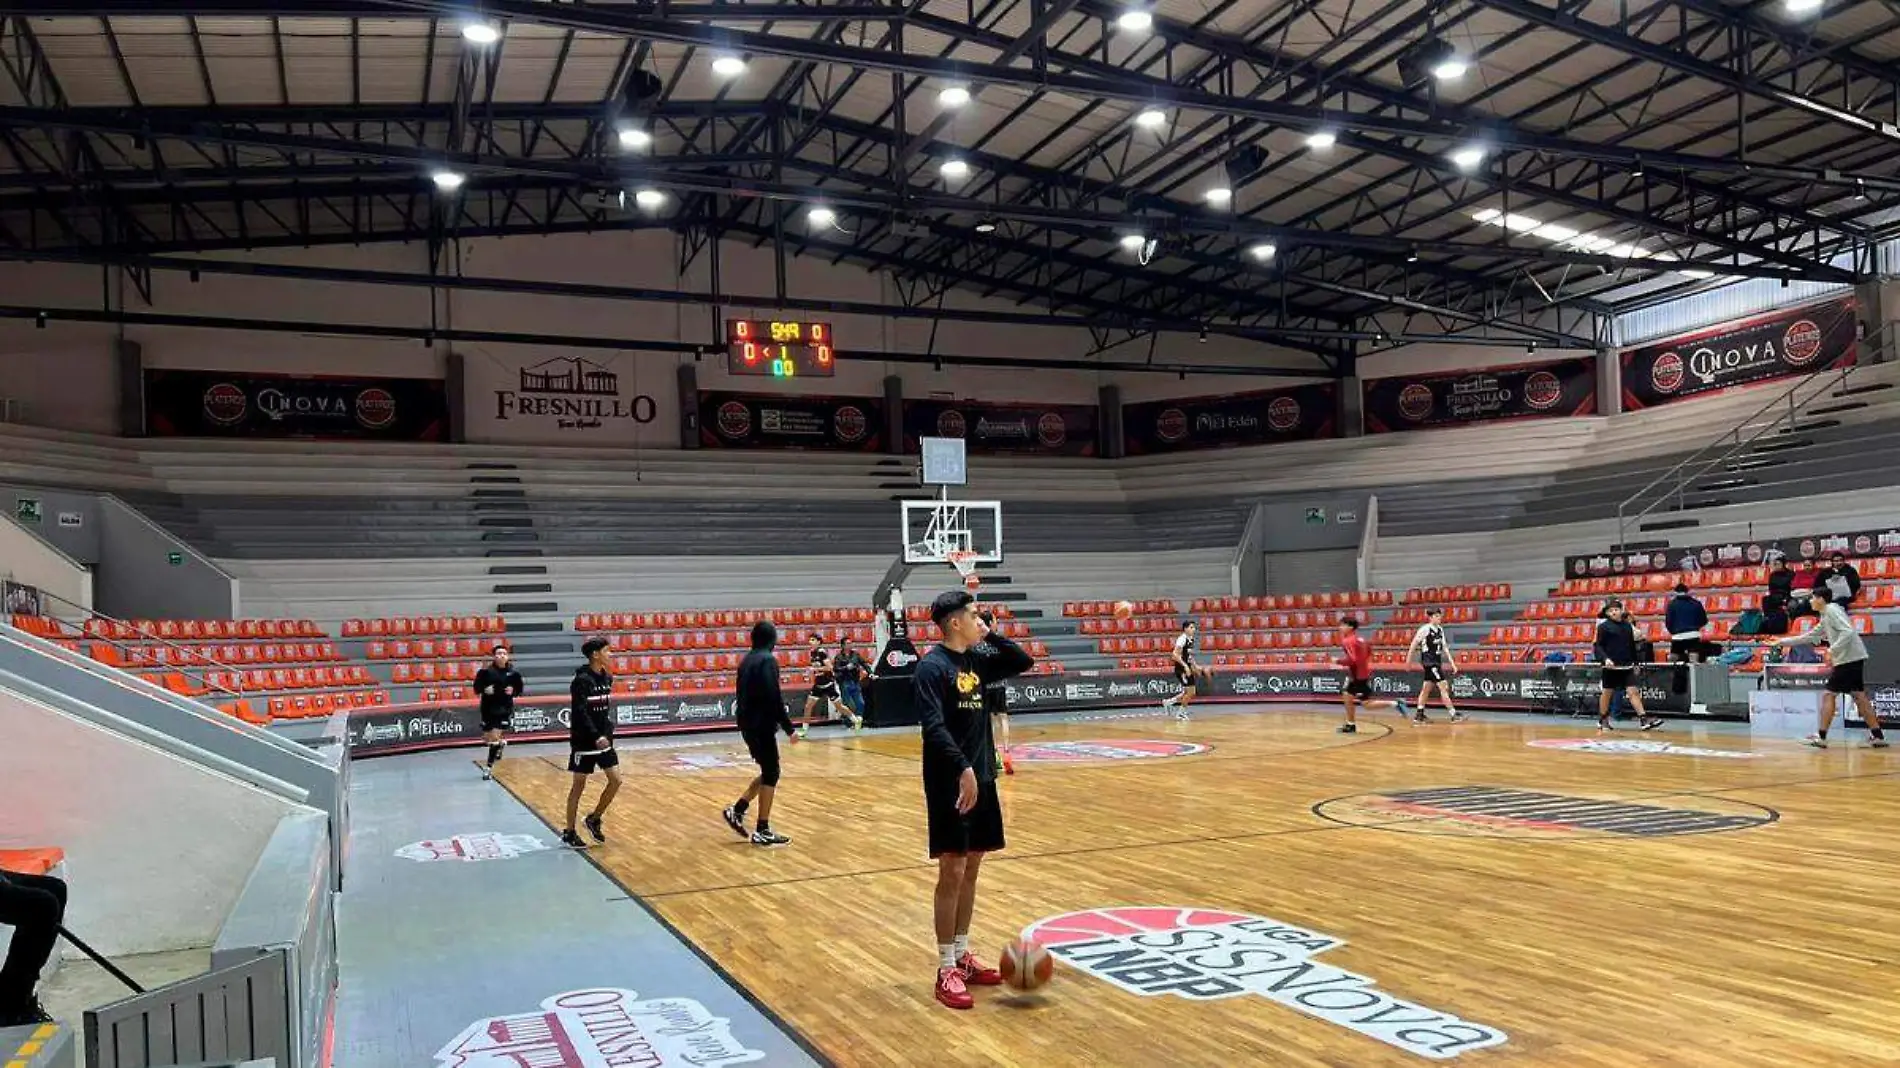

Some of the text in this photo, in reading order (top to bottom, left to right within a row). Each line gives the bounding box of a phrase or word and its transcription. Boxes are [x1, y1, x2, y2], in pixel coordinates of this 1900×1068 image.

[737, 321, 747, 337] 0
[812, 324, 822, 339] 0
[744, 343, 755, 360] 0
[819, 346, 829, 362] 0
[1698, 342, 1776, 373] INOVA
[495, 391, 656, 423] FRESNILLO
[1230, 920, 1334, 952] LIGA
[1046, 939, 1245, 997] LNBP
